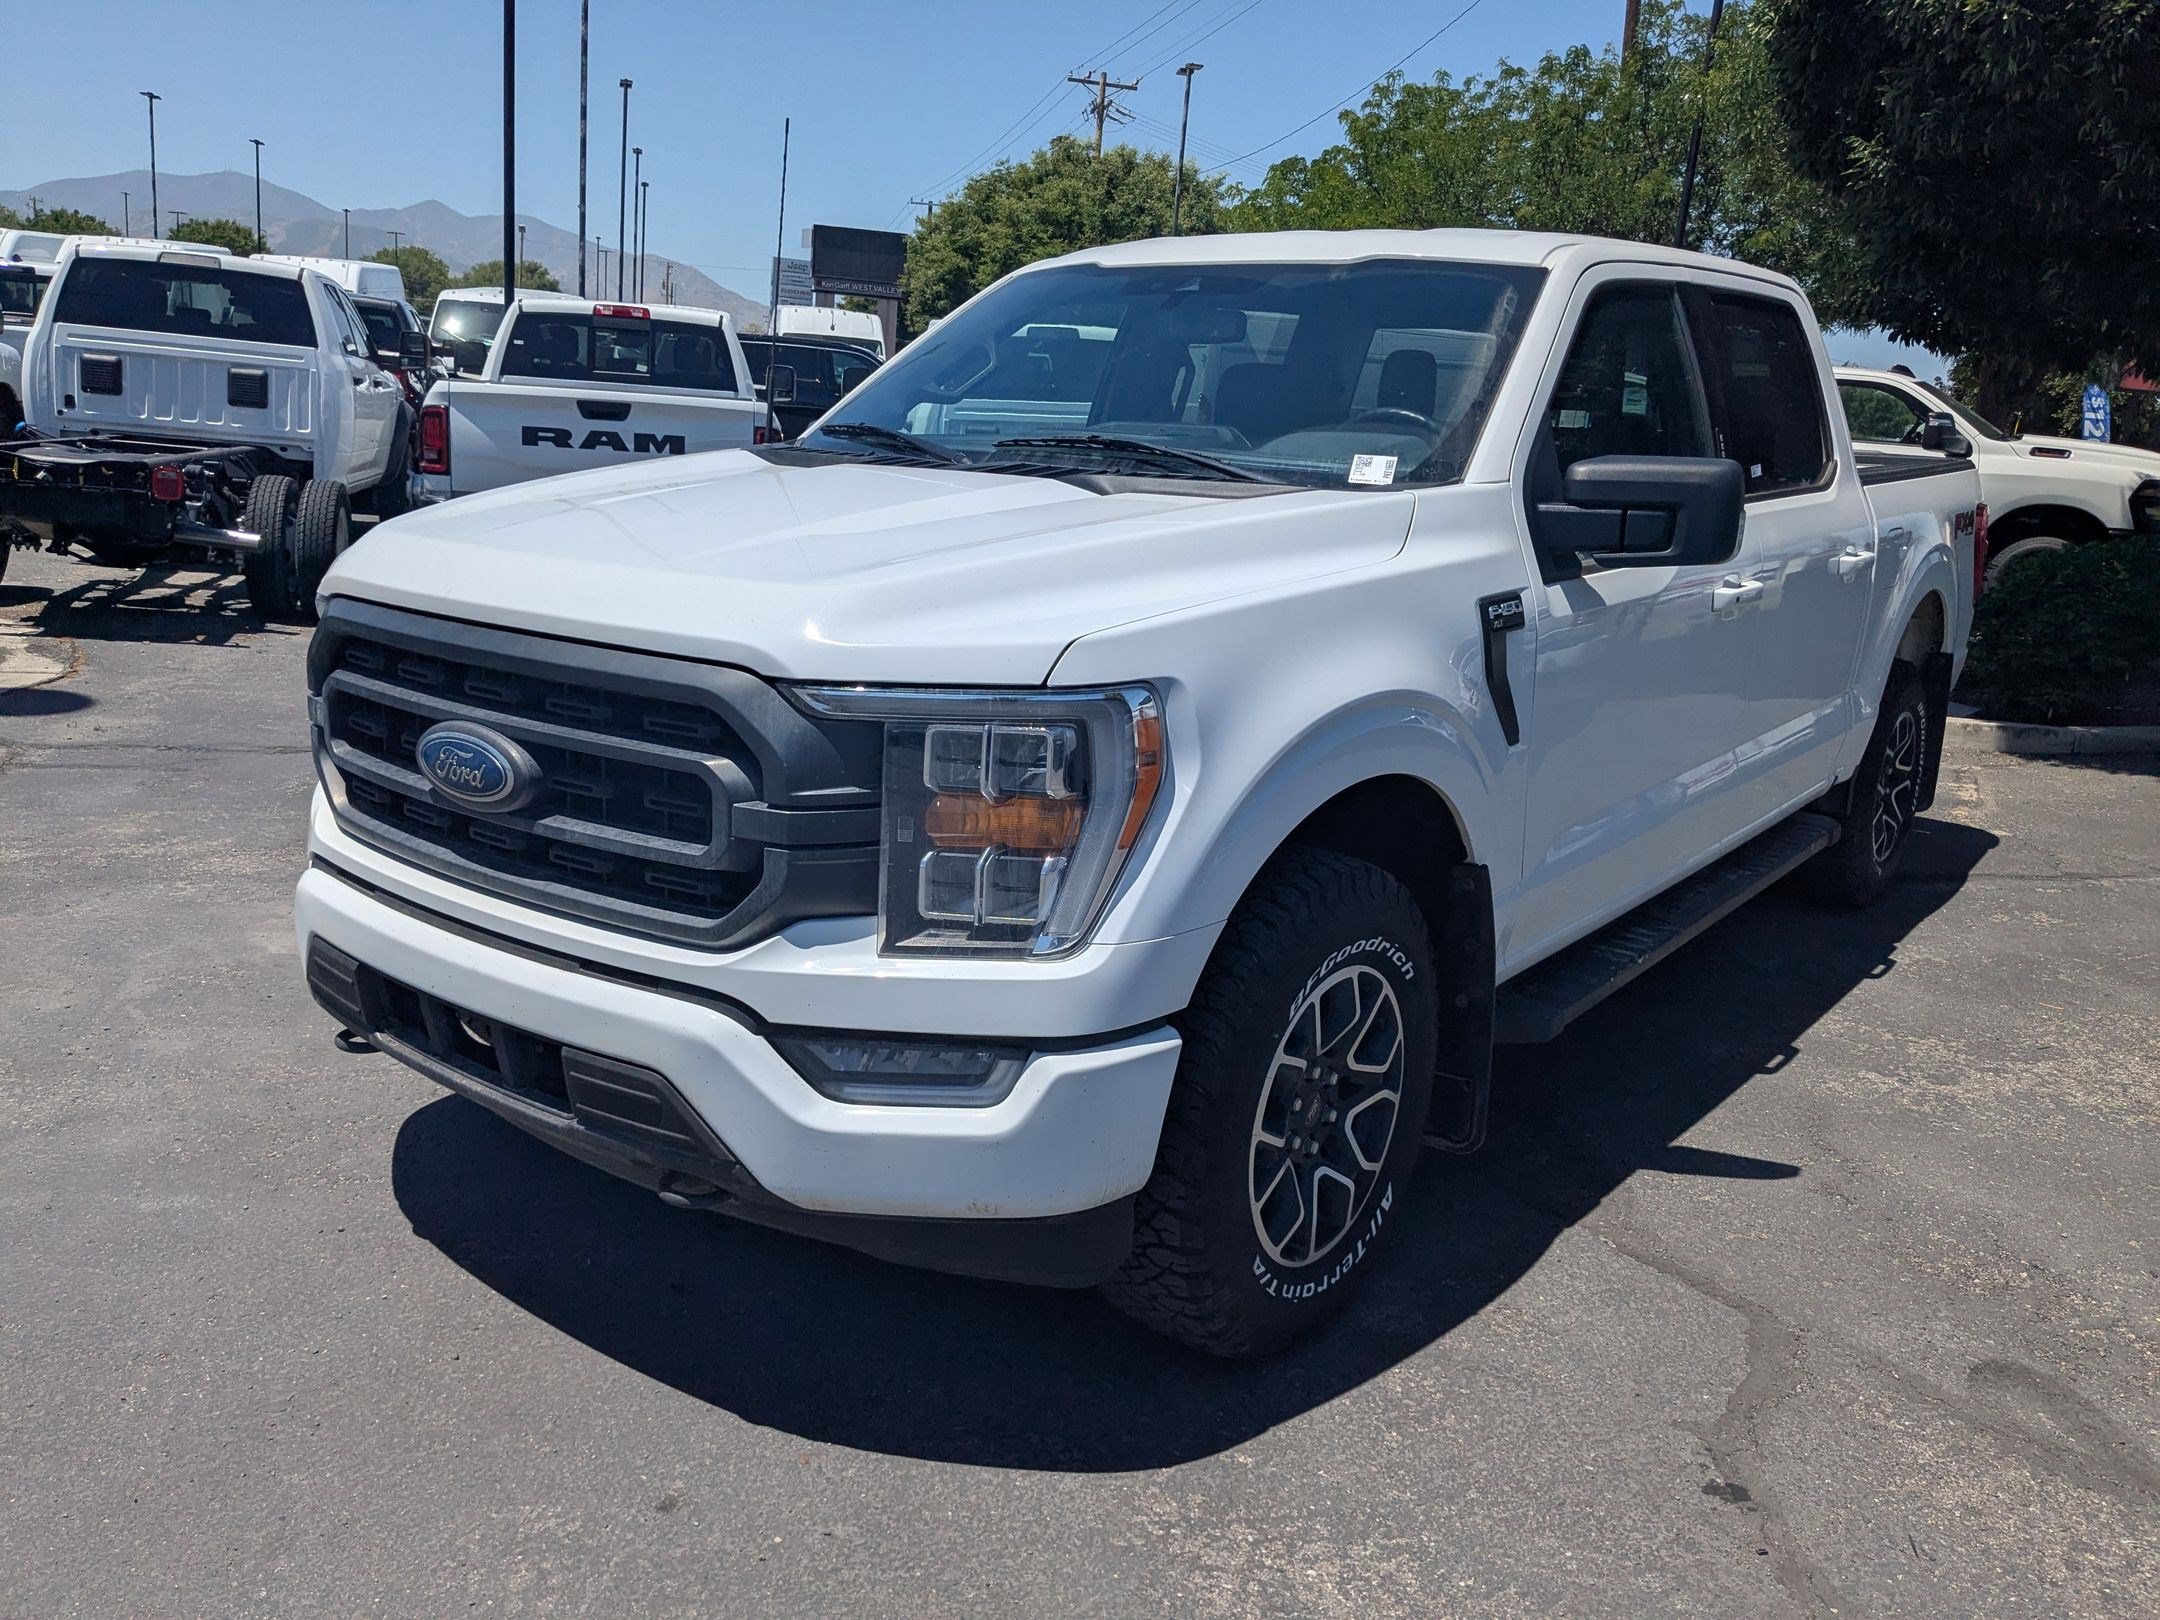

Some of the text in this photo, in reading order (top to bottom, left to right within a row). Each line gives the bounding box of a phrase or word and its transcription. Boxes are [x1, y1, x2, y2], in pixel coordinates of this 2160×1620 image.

[821, 280, 834, 288] Ken
[851, 282, 873, 292] WEST
[873, 285, 903, 294] VALLEY
[521, 426, 686, 455] RAM
[2083, 396, 2106, 442] $12
[435, 745, 485, 788] Ford
[1288, 935, 1416, 1022] BFGoodrich
